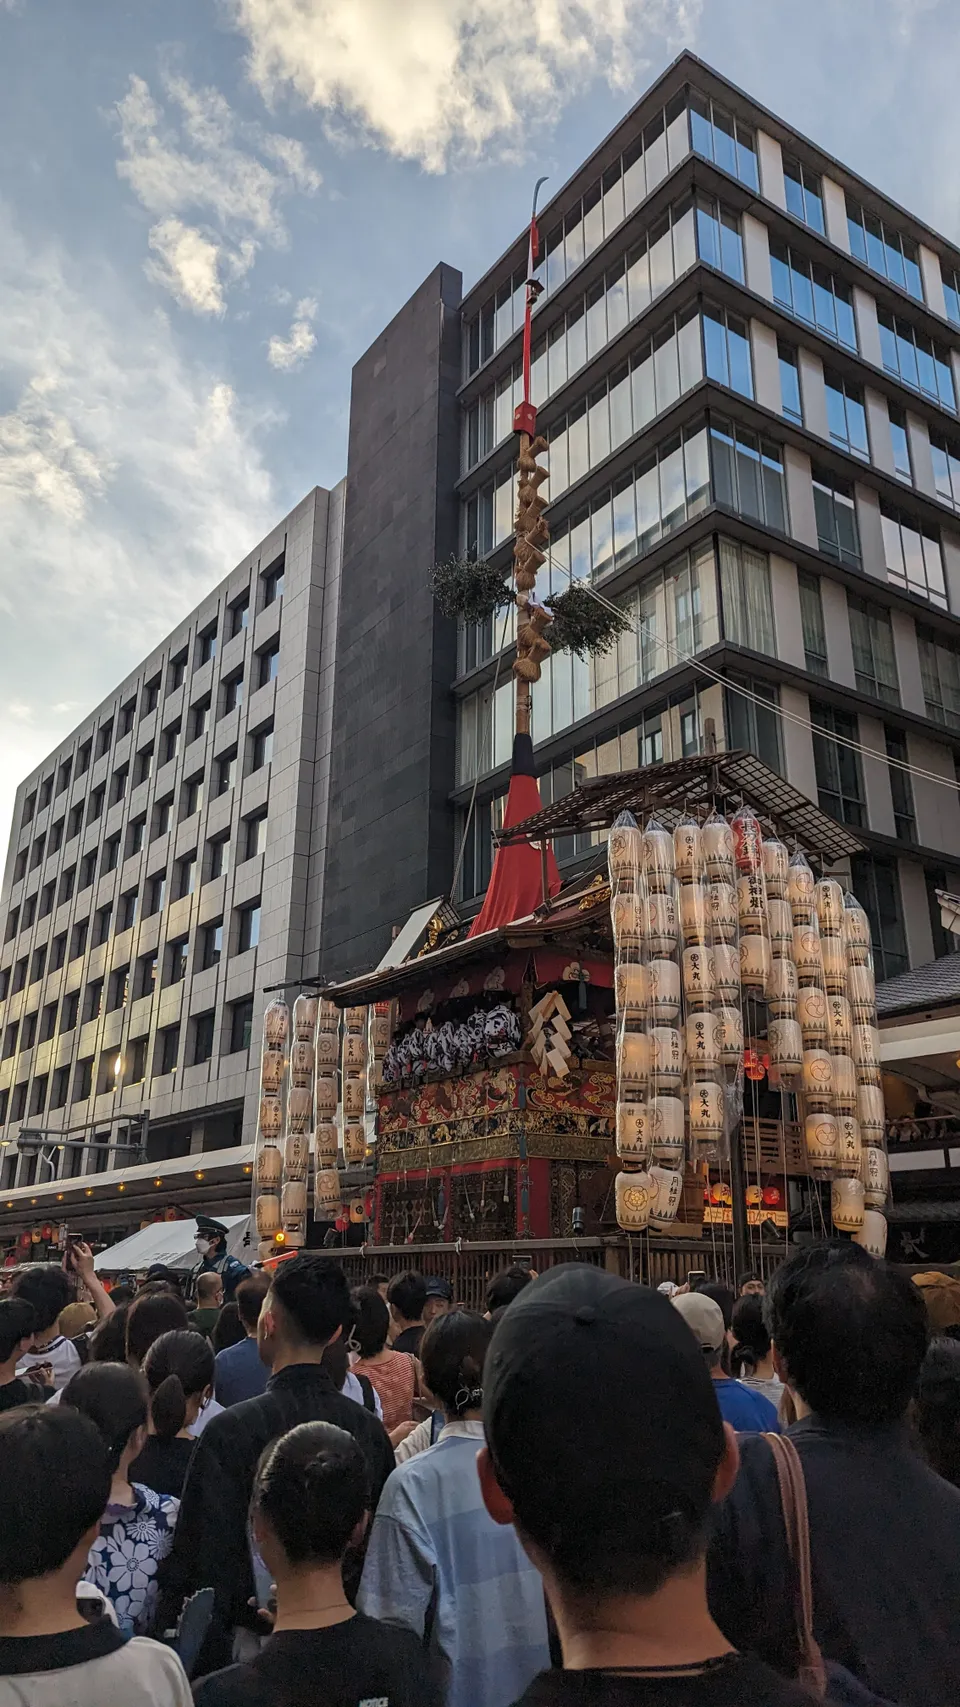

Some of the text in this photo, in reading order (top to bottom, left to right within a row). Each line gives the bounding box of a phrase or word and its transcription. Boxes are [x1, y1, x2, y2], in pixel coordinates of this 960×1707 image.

[691, 962, 701, 981] 大丸
[833, 1009, 843, 1027] 大丸
[695, 1031, 706, 1050] 大丸
[700, 1098, 711, 1118] 大丸
[636, 1129, 643, 1143] 大丸
[845, 1130, 855, 1149] 大丸
